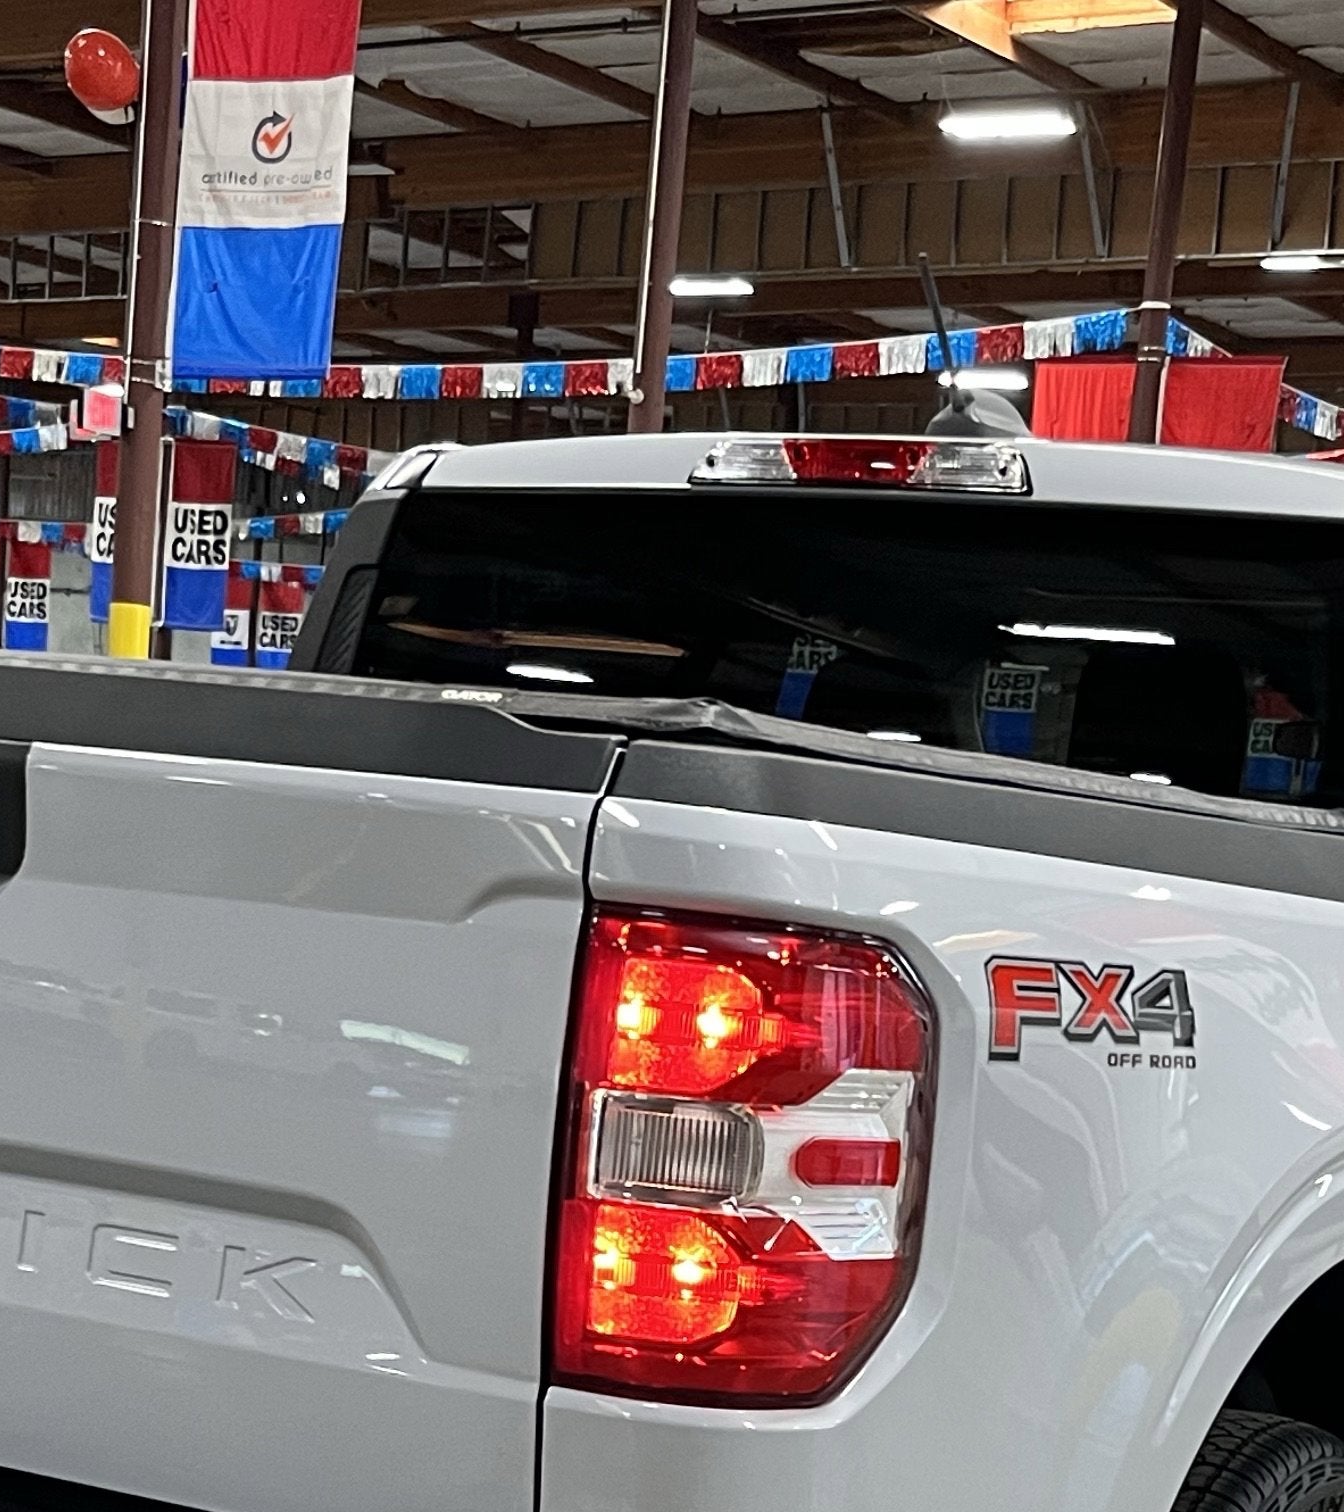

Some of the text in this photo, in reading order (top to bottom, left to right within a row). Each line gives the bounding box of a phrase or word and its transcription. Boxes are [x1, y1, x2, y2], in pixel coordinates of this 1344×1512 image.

[263, 166, 334, 188] pre-owed
[173, 508, 229, 536] USED
[171, 536, 227, 565] CARS
[9, 581, 47, 600] USED
[262, 615, 299, 632] USED
[988, 672, 1035, 690] USED
[985, 691, 1033, 709] CARS
[984, 955, 1196, 1064] FX4
[1106, 1052, 1197, 1069] OFF ROAD
